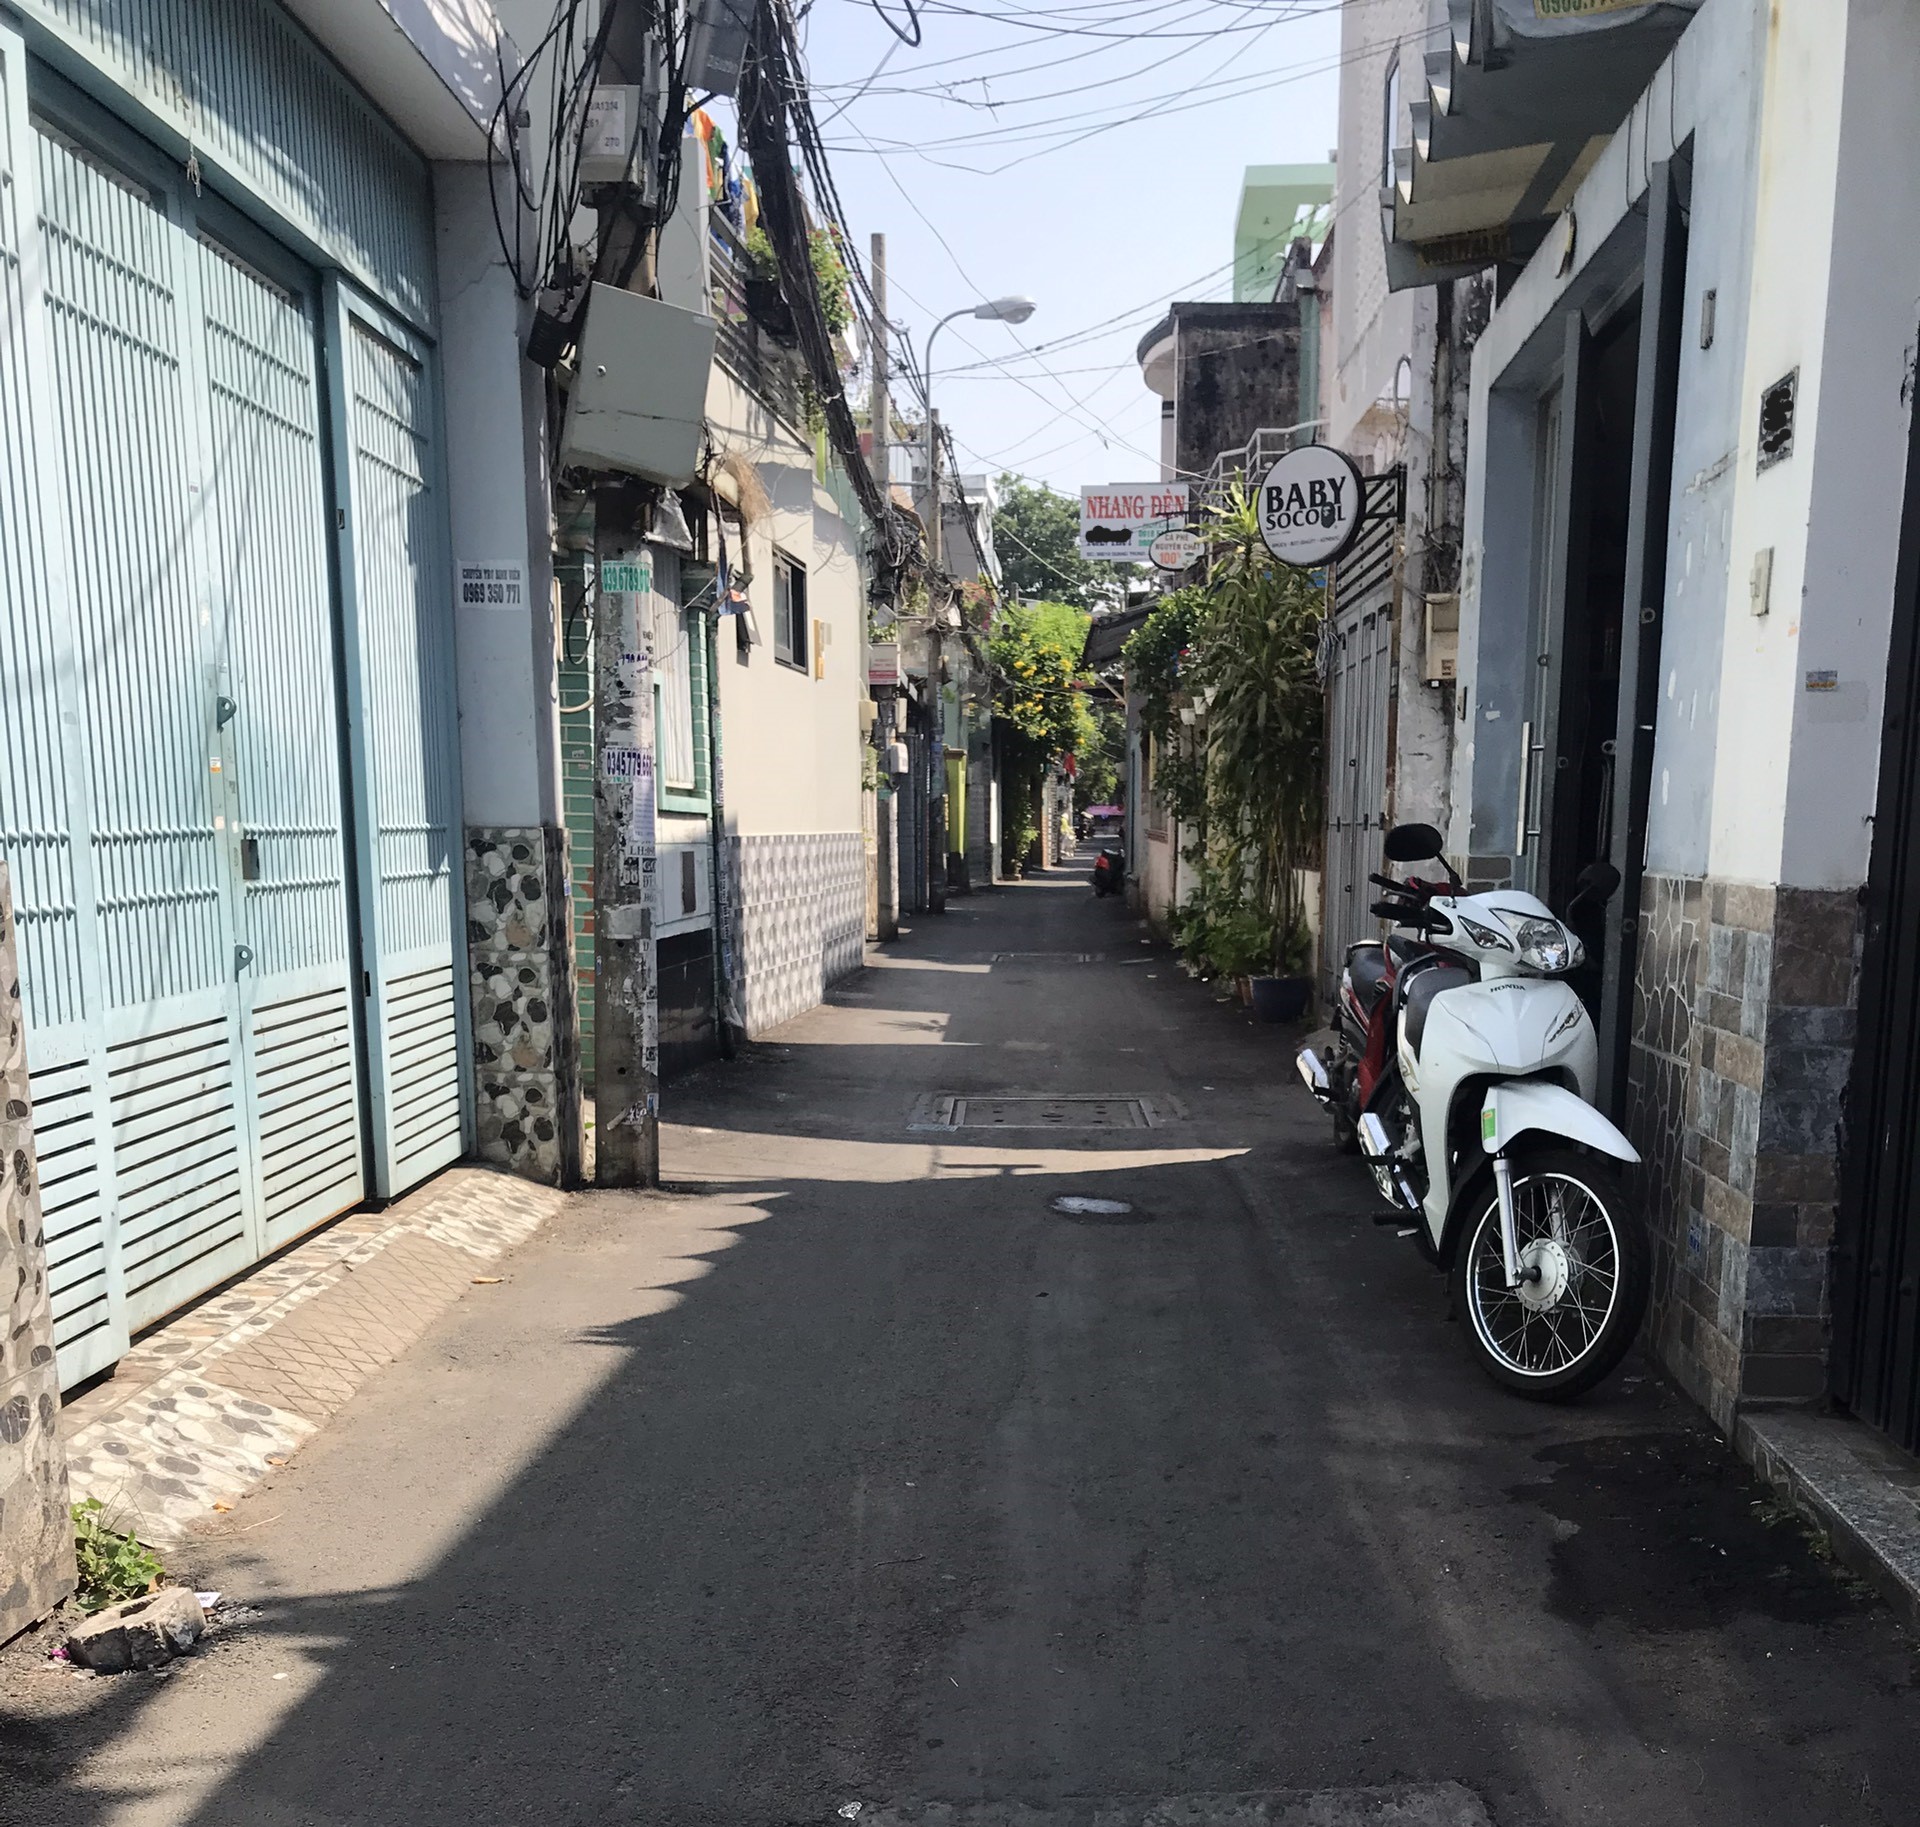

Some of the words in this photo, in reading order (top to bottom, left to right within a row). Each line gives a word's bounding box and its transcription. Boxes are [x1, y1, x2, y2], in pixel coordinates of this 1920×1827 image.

[605, 136, 621, 147] 270
[1265, 476, 1347, 514] BABY
[1086, 495, 1145, 519] NHANG
[1265, 504, 1347, 531] SOCOL
[463, 583, 485, 603] 0969
[487, 583, 504, 604] 350
[505, 583, 521, 604] 771
[1490, 983, 1526, 993] HONDA
